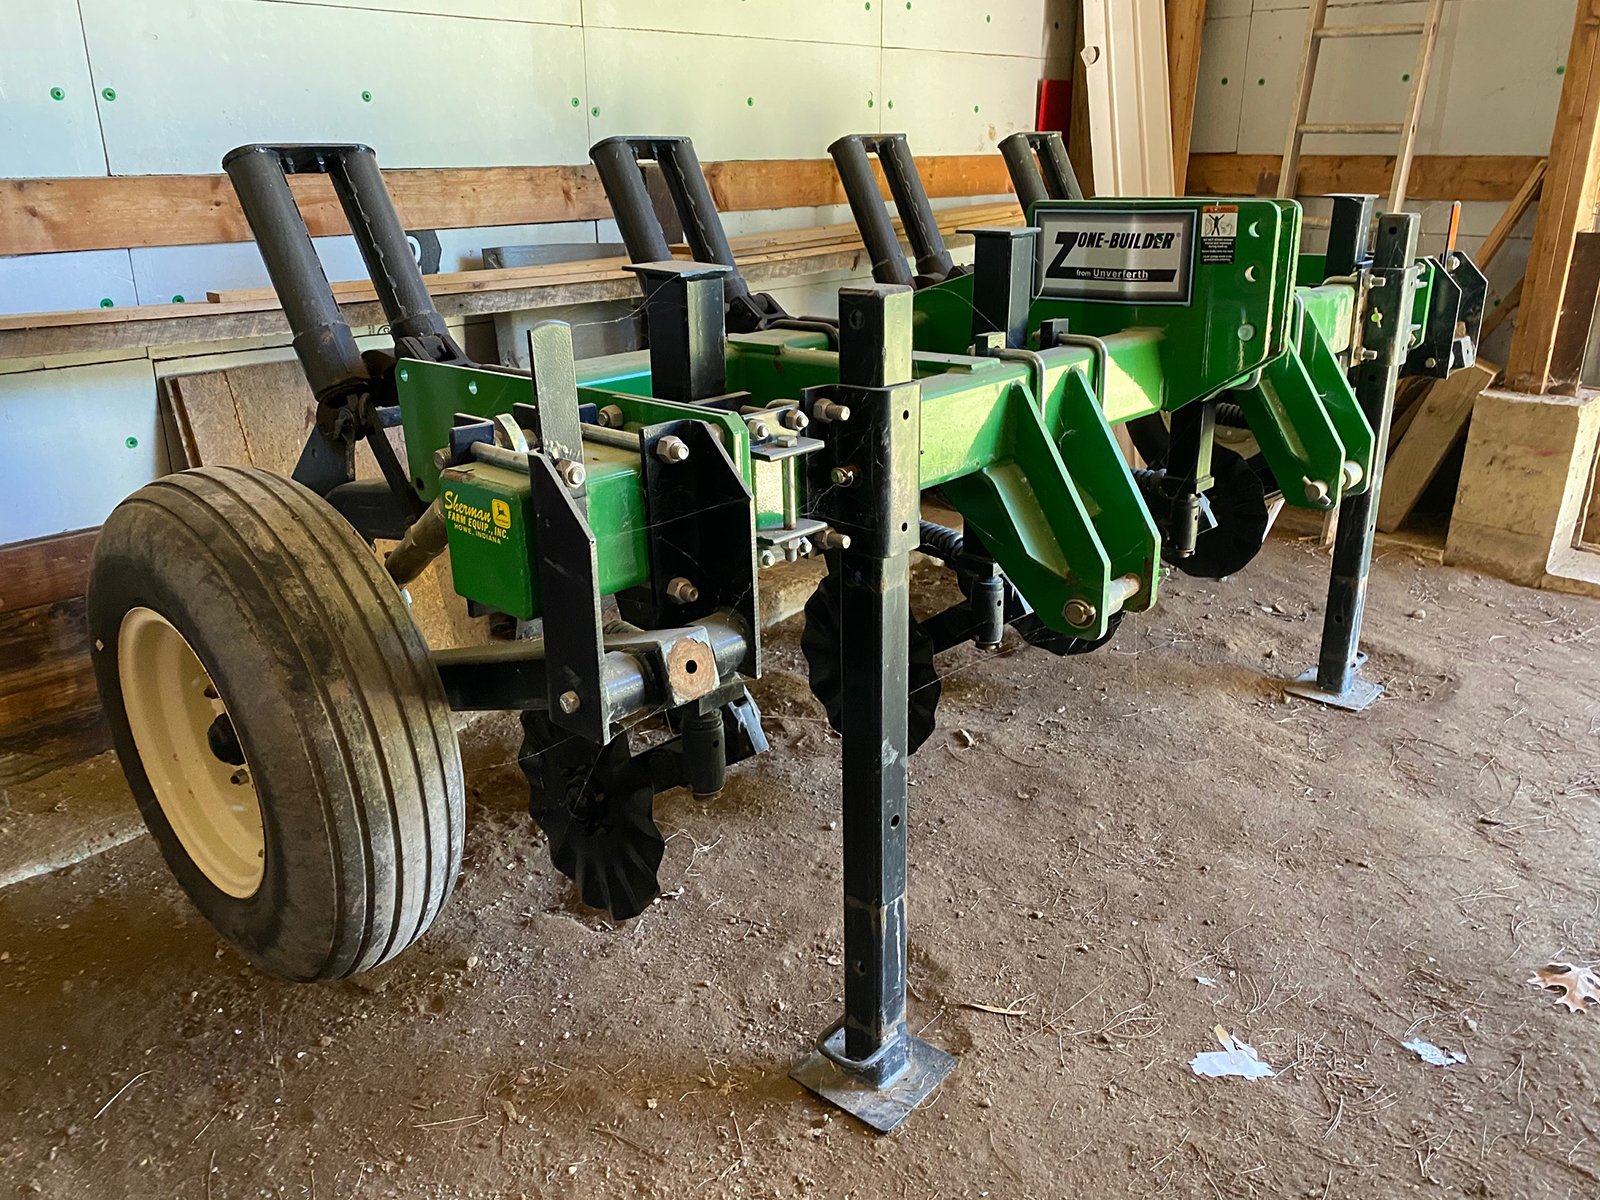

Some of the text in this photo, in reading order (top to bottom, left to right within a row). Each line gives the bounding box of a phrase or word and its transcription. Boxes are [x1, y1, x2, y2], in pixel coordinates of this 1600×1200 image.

[1076, 268, 1148, 280] from Unverferth
[444, 490, 492, 522] Sherman
[447, 510, 466, 525] FARM
[494, 526, 509, 540] INC.
[475, 530, 502, 545] INDIANA
